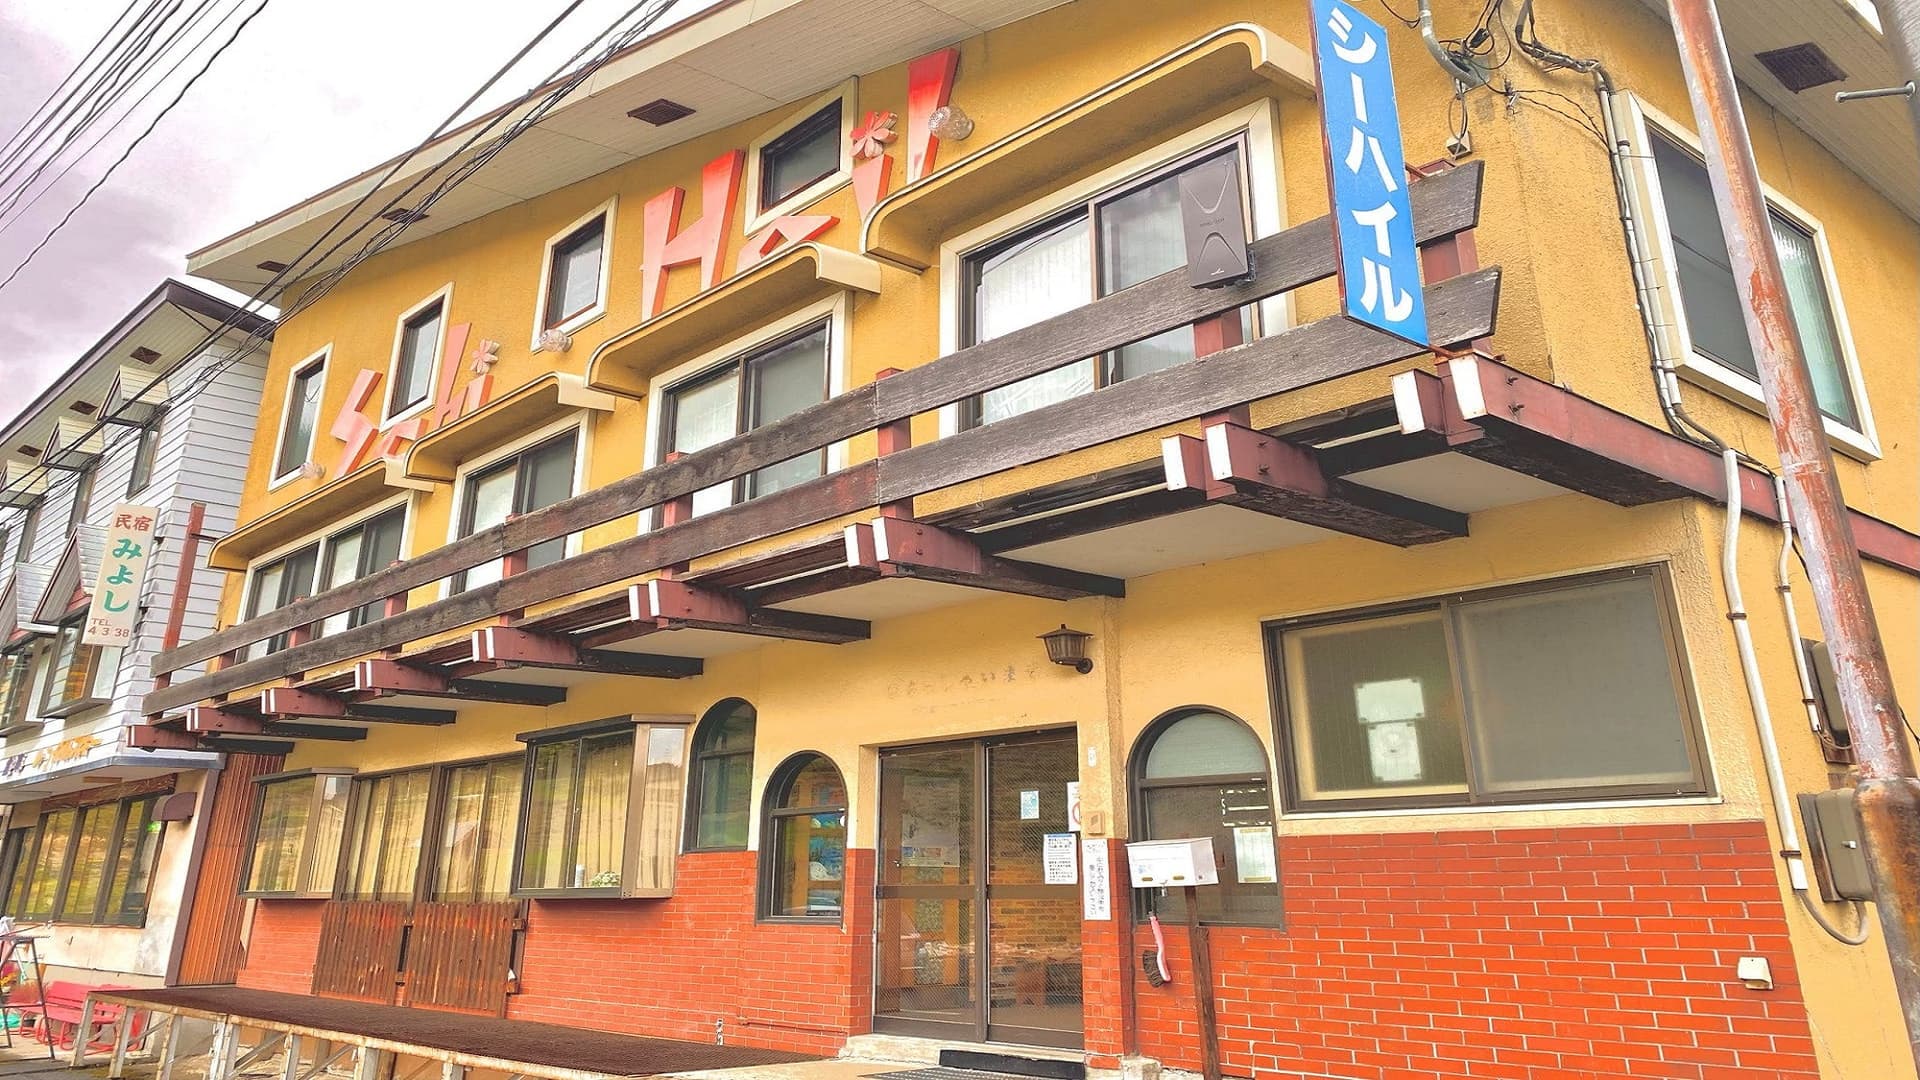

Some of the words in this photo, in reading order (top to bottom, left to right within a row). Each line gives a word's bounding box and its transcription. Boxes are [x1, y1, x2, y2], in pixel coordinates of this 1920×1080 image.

[1327, 7, 1413, 322] シーハイル
[115, 513, 153, 532] 民宿
[103, 538, 143, 612] みよし
[91, 617, 113, 627] TEL
